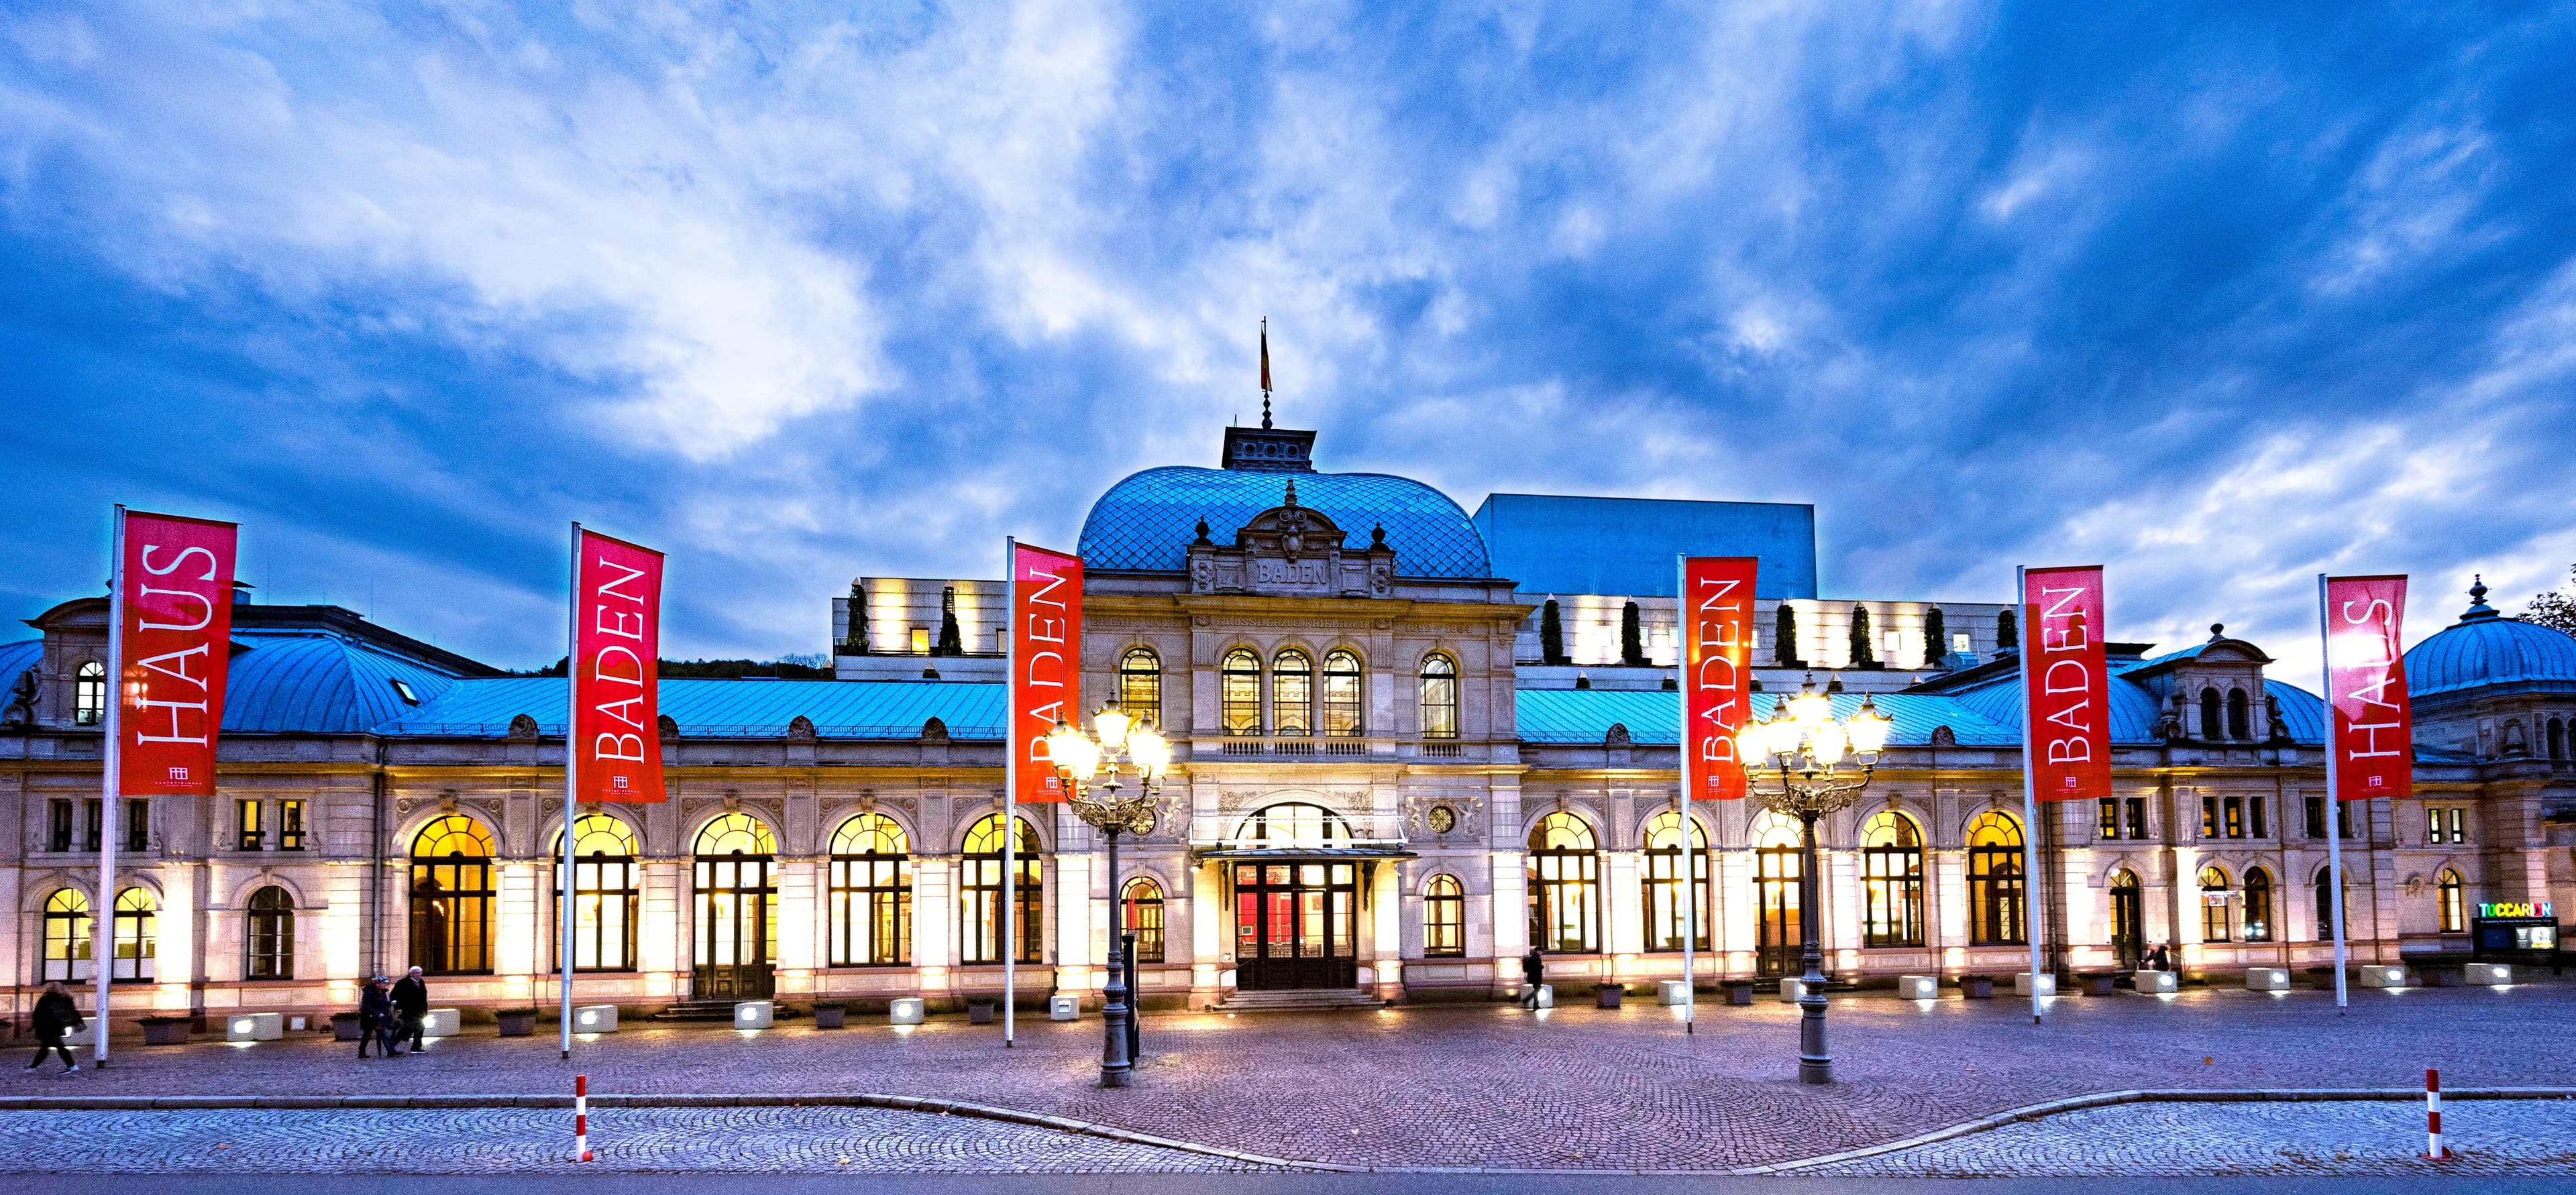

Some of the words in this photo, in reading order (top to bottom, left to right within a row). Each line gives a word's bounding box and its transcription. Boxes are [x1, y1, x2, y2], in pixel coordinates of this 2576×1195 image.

[135, 545, 217, 749] HAUS
[596, 555, 645, 764] BADEN
[1257, 563, 1327, 585] BADEN
[1700, 576, 1741, 763] BADEN
[2043, 586, 2090, 766] BADEN
[2343, 599, 2400, 762] HAUS
[2479, 902, 2553, 917] TOCCARION
